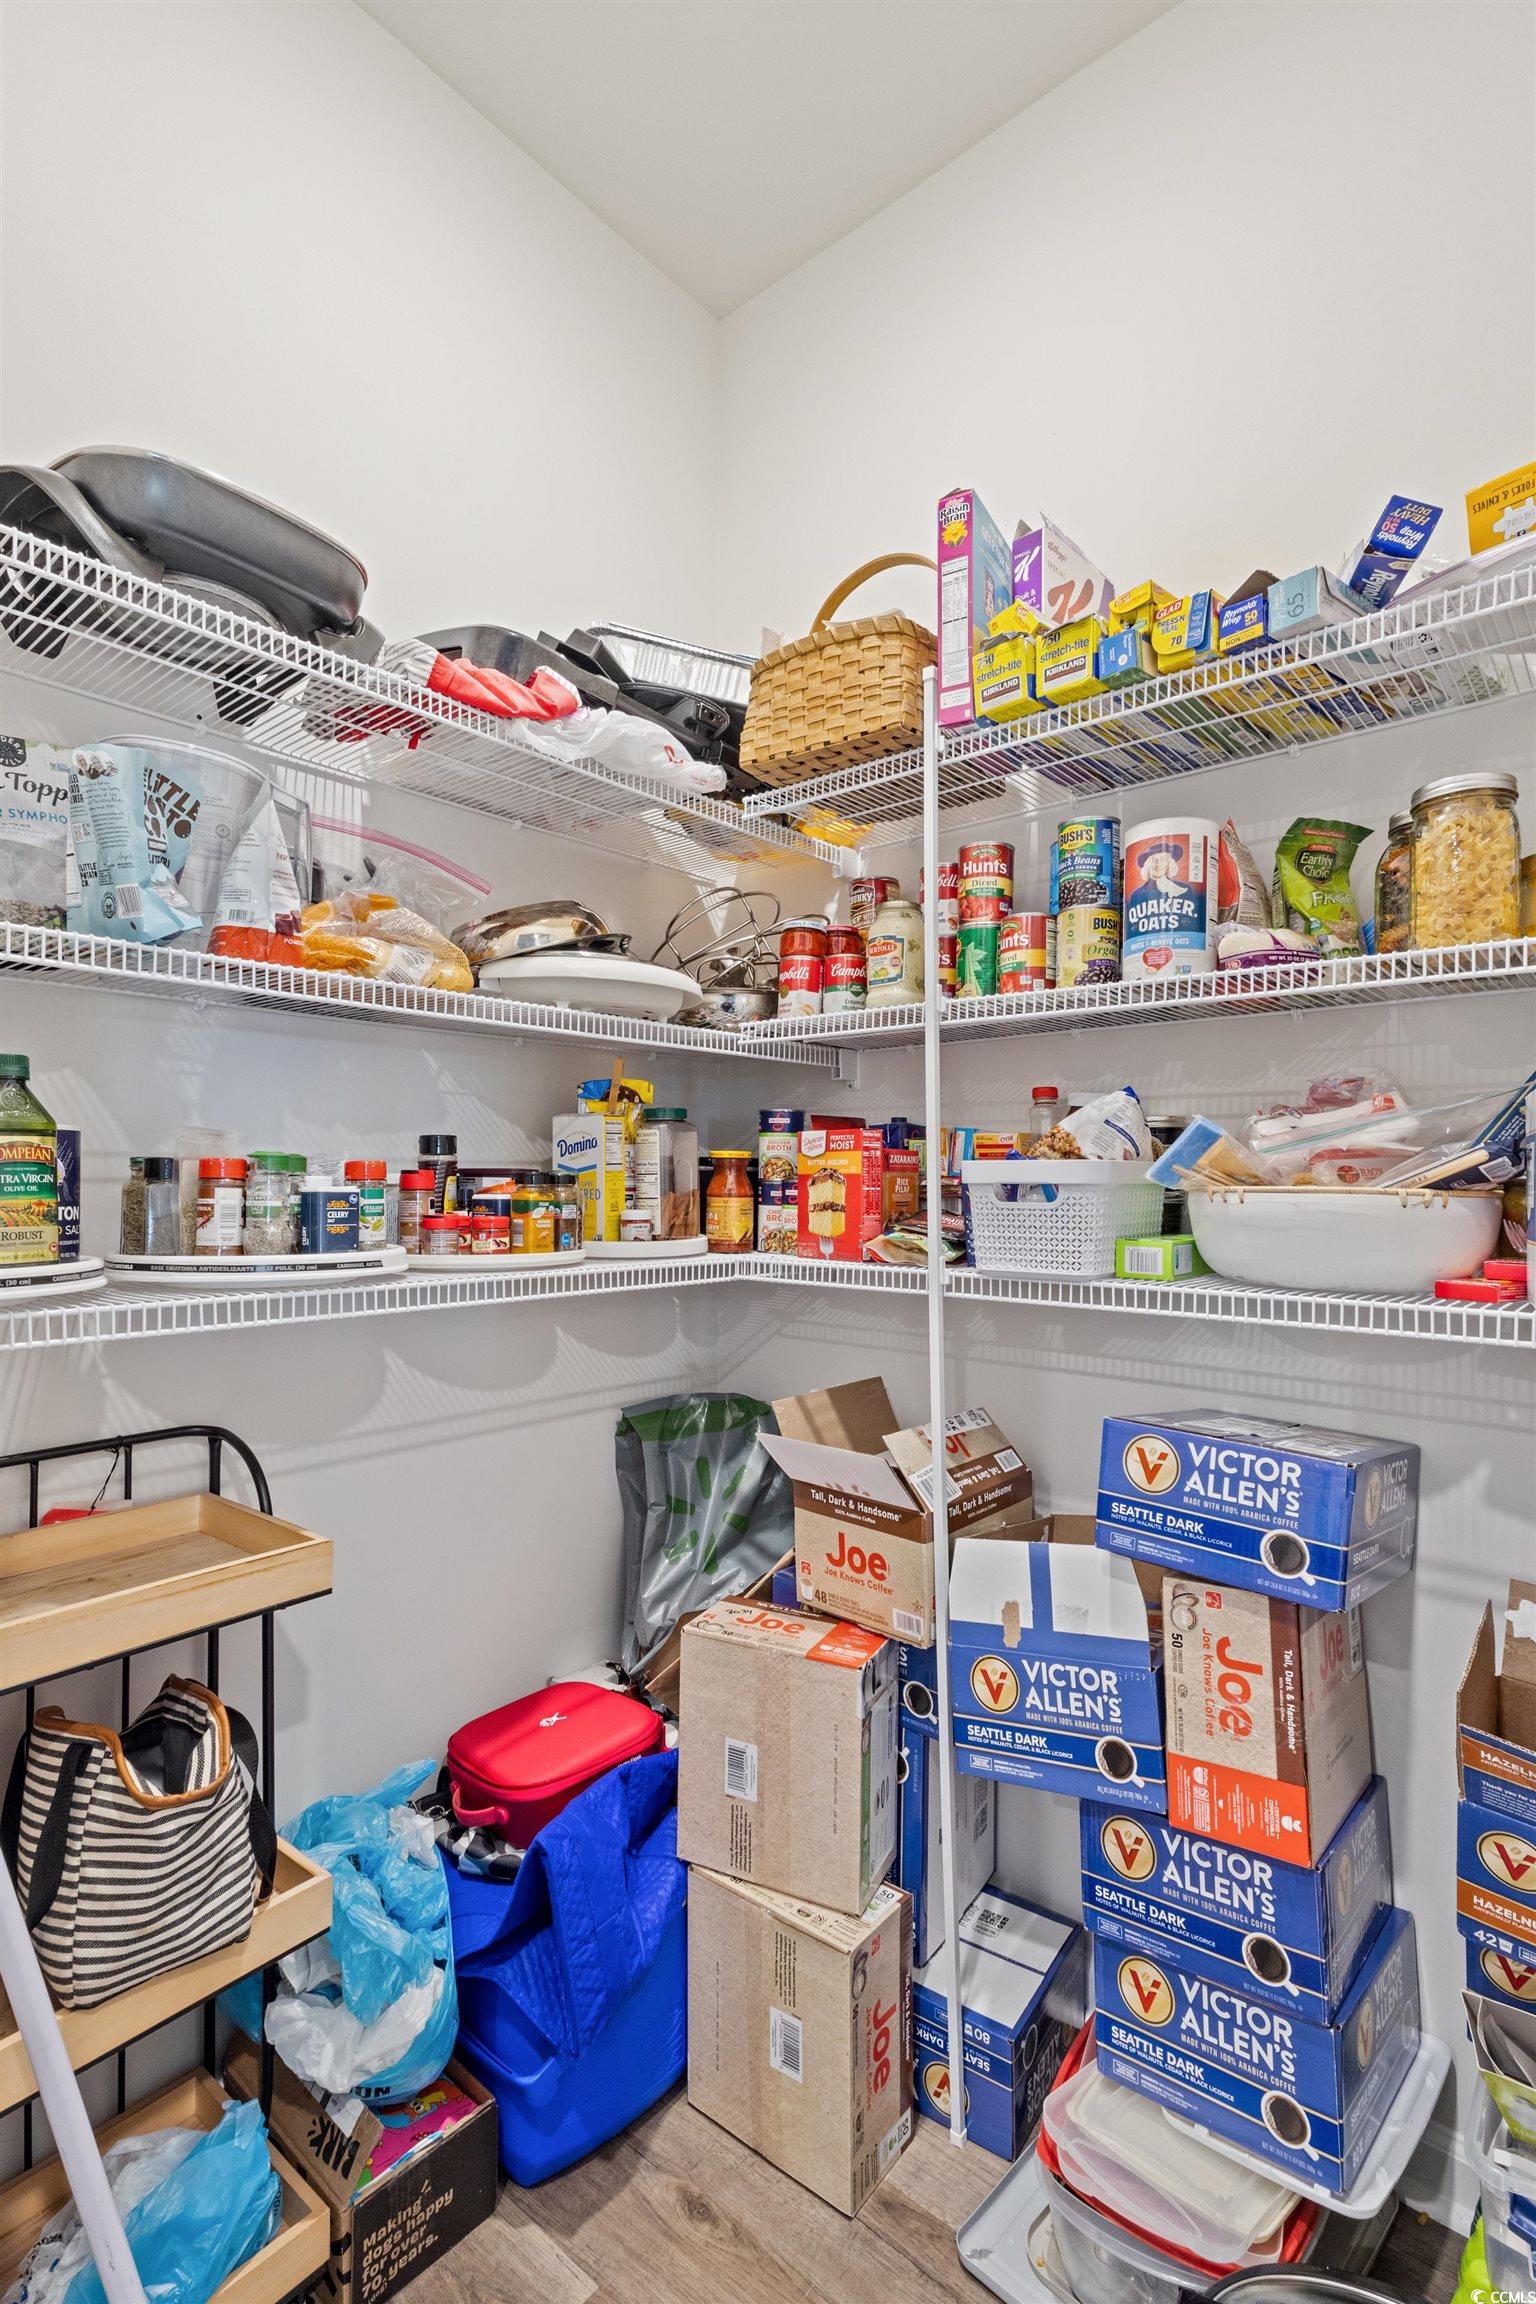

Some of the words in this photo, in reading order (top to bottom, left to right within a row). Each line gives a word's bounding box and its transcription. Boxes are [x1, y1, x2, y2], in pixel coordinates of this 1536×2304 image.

[1502, 491, 1508, 500] &
[1512, 479, 1536, 496] FORKS
[940, 503, 969, 520] Raisin
[1403, 503, 1433, 515] DUTY
[1473, 495, 1499, 514] KNIVES
[943, 512, 967, 526] Bran
[1381, 521, 1399, 533] 50
[1390, 509, 1430, 526] HEAVY
[1377, 531, 1418, 550] Reynolds
[1400, 526, 1424, 541] Wrap
[1014, 550, 1031, 560] SPECIAL
[1156, 602, 1182, 620] GLAD
[1222, 615, 1241, 628] Wrap
[1245, 610, 1258, 621] 50
[1224, 600, 1258, 620] Reynolds
[1040, 638, 1089, 663] stretch-tite
[1041, 632, 1061, 648] 750
[1171, 635, 1182, 647] 70
[976, 653, 995, 670] 750
[976, 659, 1022, 685] stretch-tite
[1046, 657, 1085, 677] KIRKLAND
[982, 679, 1019, 697] KIRKLAND
[5, 772, 69, 806] Topp
[8, 809, 68, 824] SYMPHO
[1060, 829, 1093, 847] BUSH'S
[1073, 857, 1101, 865] Beans
[1138, 915, 1179, 932] OATS
[557, 1135, 598, 1157] Domino
[830, 1140, 854, 1150] MOIST
[21, 1174, 54, 1183] VIRGIN
[896, 1177, 909, 1185] RICE
[1, 1231, 44, 1241] ROBUST
[1187, 1442, 1301, 1488] VICTOR
[1383, 1458, 1408, 1486] VICTOR
[810, 1489, 826, 1504] Tall,
[828, 1494, 846, 1507] Dark
[849, 1500, 855, 1509] &
[858, 1502, 899, 1521] Handsome
[949, 1505, 962, 1517] Tall,
[963, 1498, 976, 1510] Dark
[977, 1496, 983, 1505] &
[984, 1486, 1011, 1502] Handsome
[1184, 1471, 1303, 1518] ALLEN'S
[1111, 1502, 1163, 1525] SEATTLE
[1166, 1516, 1204, 1535] DARK
[1183, 1496, 1201, 1507] MADE
[1203, 1499, 1220, 1512] WITH
[1222, 1503, 1239, 1516] 100%
[1241, 1507, 1271, 1523] ARABICA
[1273, 1514, 1299, 1530] COFFEE
[826, 1532, 887, 1581] Joe
[824, 1566, 837, 1577] Joe
[840, 1571, 865, 1586] Knows
[867, 1580, 893, 1596] Coffee
[815, 1589, 827, 1603] 48
[736, 1613, 806, 1634] Joe
[1171, 1632, 1183, 1648] 50
[1202, 1628, 1213, 1650] Joe
[1283, 1649, 1292, 1668] Tall,
[1021, 1659, 1118, 1695] VICTOR
[1202, 1655, 1213, 1694] Knows
[1285, 1671, 1293, 1692] Dark
[1215, 1636, 1264, 1738] Joe
[1025, 1687, 1122, 1723] ALLEN'S
[1204, 1698, 1214, 1736] Coffee
[1286, 1703, 1294, 1752] Handsome
[967, 1725, 1013, 1742] SEATTLE
[1015, 1733, 1048, 1748] DARK
[1480, 1750, 1536, 1779] HAZELN
[1481, 1780, 1502, 1792] Thank
[1503, 1787, 1517, 1797] you
[1518, 1791, 1529, 1800] for
[1160, 1828, 1273, 1891] VICTOR
[879, 1889, 895, 1899] 50
[1162, 1861, 1277, 1923] ALLEN'S
[1094, 1885, 1147, 1913] SEATTLE
[1149, 1904, 1186, 1930] DARK
[1162, 1887, 1181, 1900] MADE
[1183, 1893, 1199, 1906] WITH
[1200, 1899, 1217, 1913] 100%
[1220, 1906, 1249, 1924] ARABICA
[1251, 1917, 1277, 1935] COFFEE
[1473, 1929, 1498, 1947] 42
[1178, 1973, 1293, 2049] VICTOR
[872, 1999, 897, 2094] Joe
[915, 2024, 945, 2049] DARK
[974, 2029, 990, 2044] 80
[1180, 2007, 1297, 2082] ALLEN'S
[1111, 2025, 1163, 2060] SEATTLE
[1166, 2051, 1205, 2081] DARK
[309, 2115, 360, 2180] BARK
[363, 2202, 422, 2253] Making
[363, 2229, 403, 2268] dogs
[406, 2188, 454, 2233] happy
[362, 2255, 388, 2284] for
[390, 2225, 427, 2262] over
[362, 2275, 384, 2299] 70
[388, 2235, 439, 2282] years.
